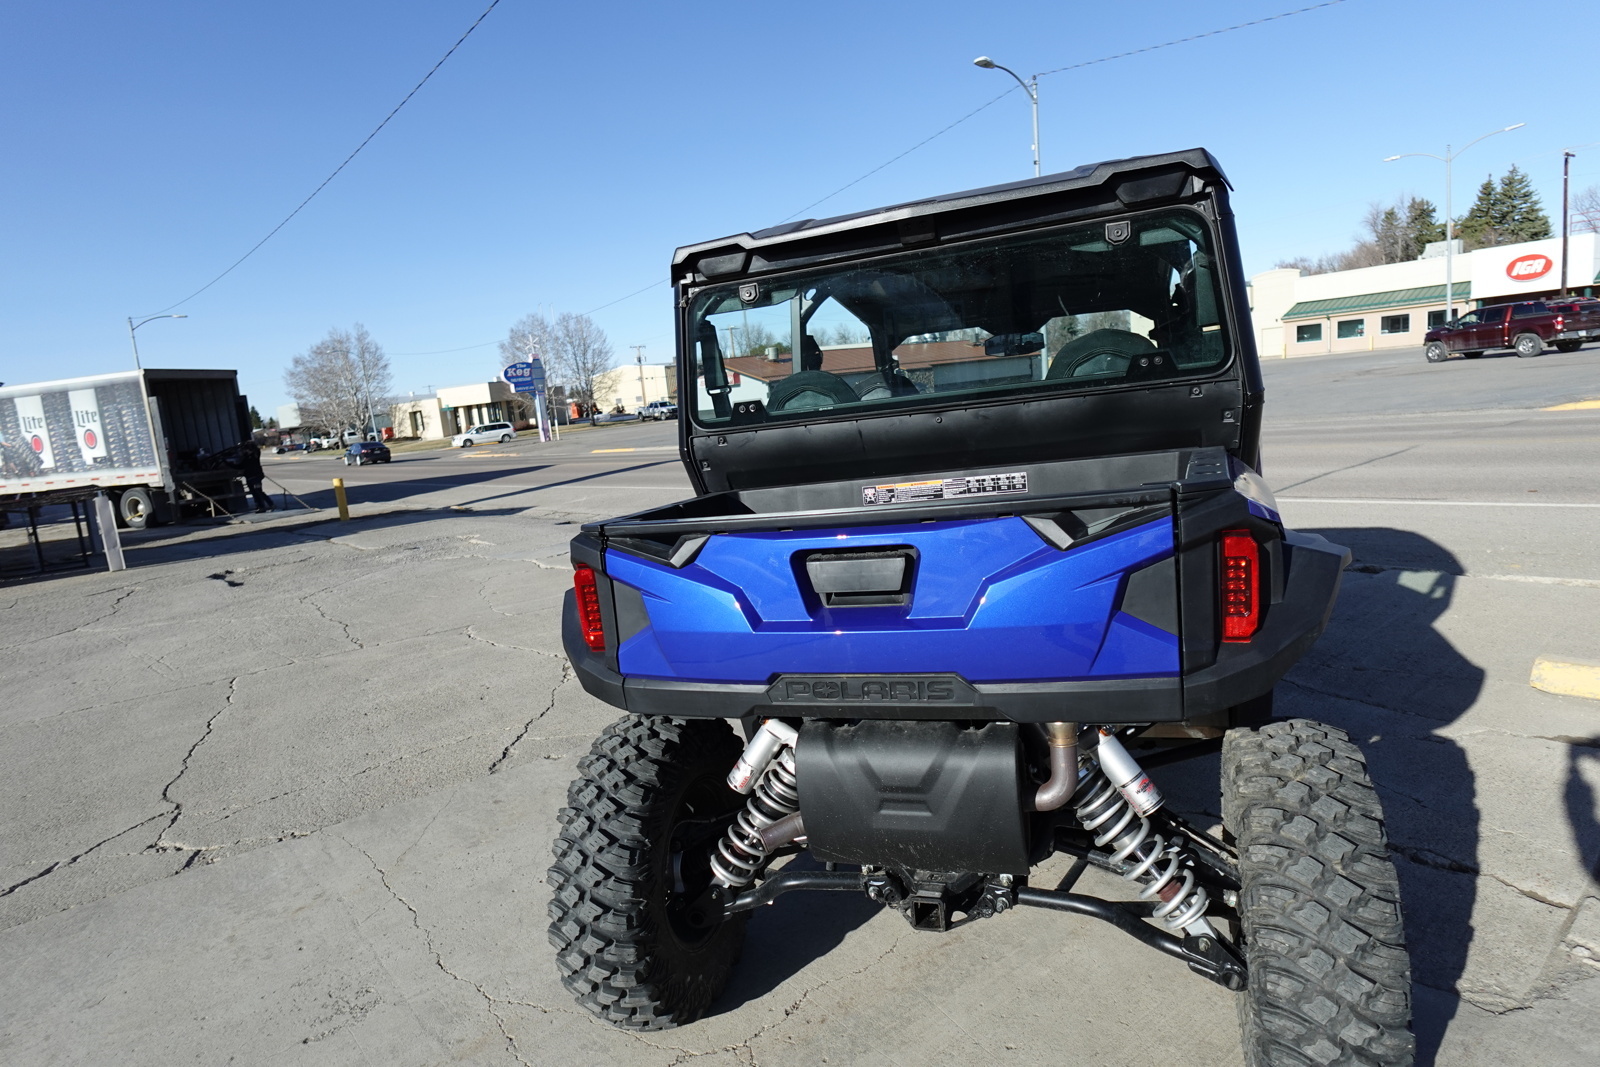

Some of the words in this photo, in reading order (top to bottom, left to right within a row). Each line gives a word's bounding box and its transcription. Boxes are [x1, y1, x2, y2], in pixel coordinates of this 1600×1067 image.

[1510, 258, 1547, 277] IGA
[506, 367, 532, 377] Keg
[21, 416, 43, 434] Lite
[75, 410, 97, 428] Lite
[785, 681, 955, 700] POLARIS
